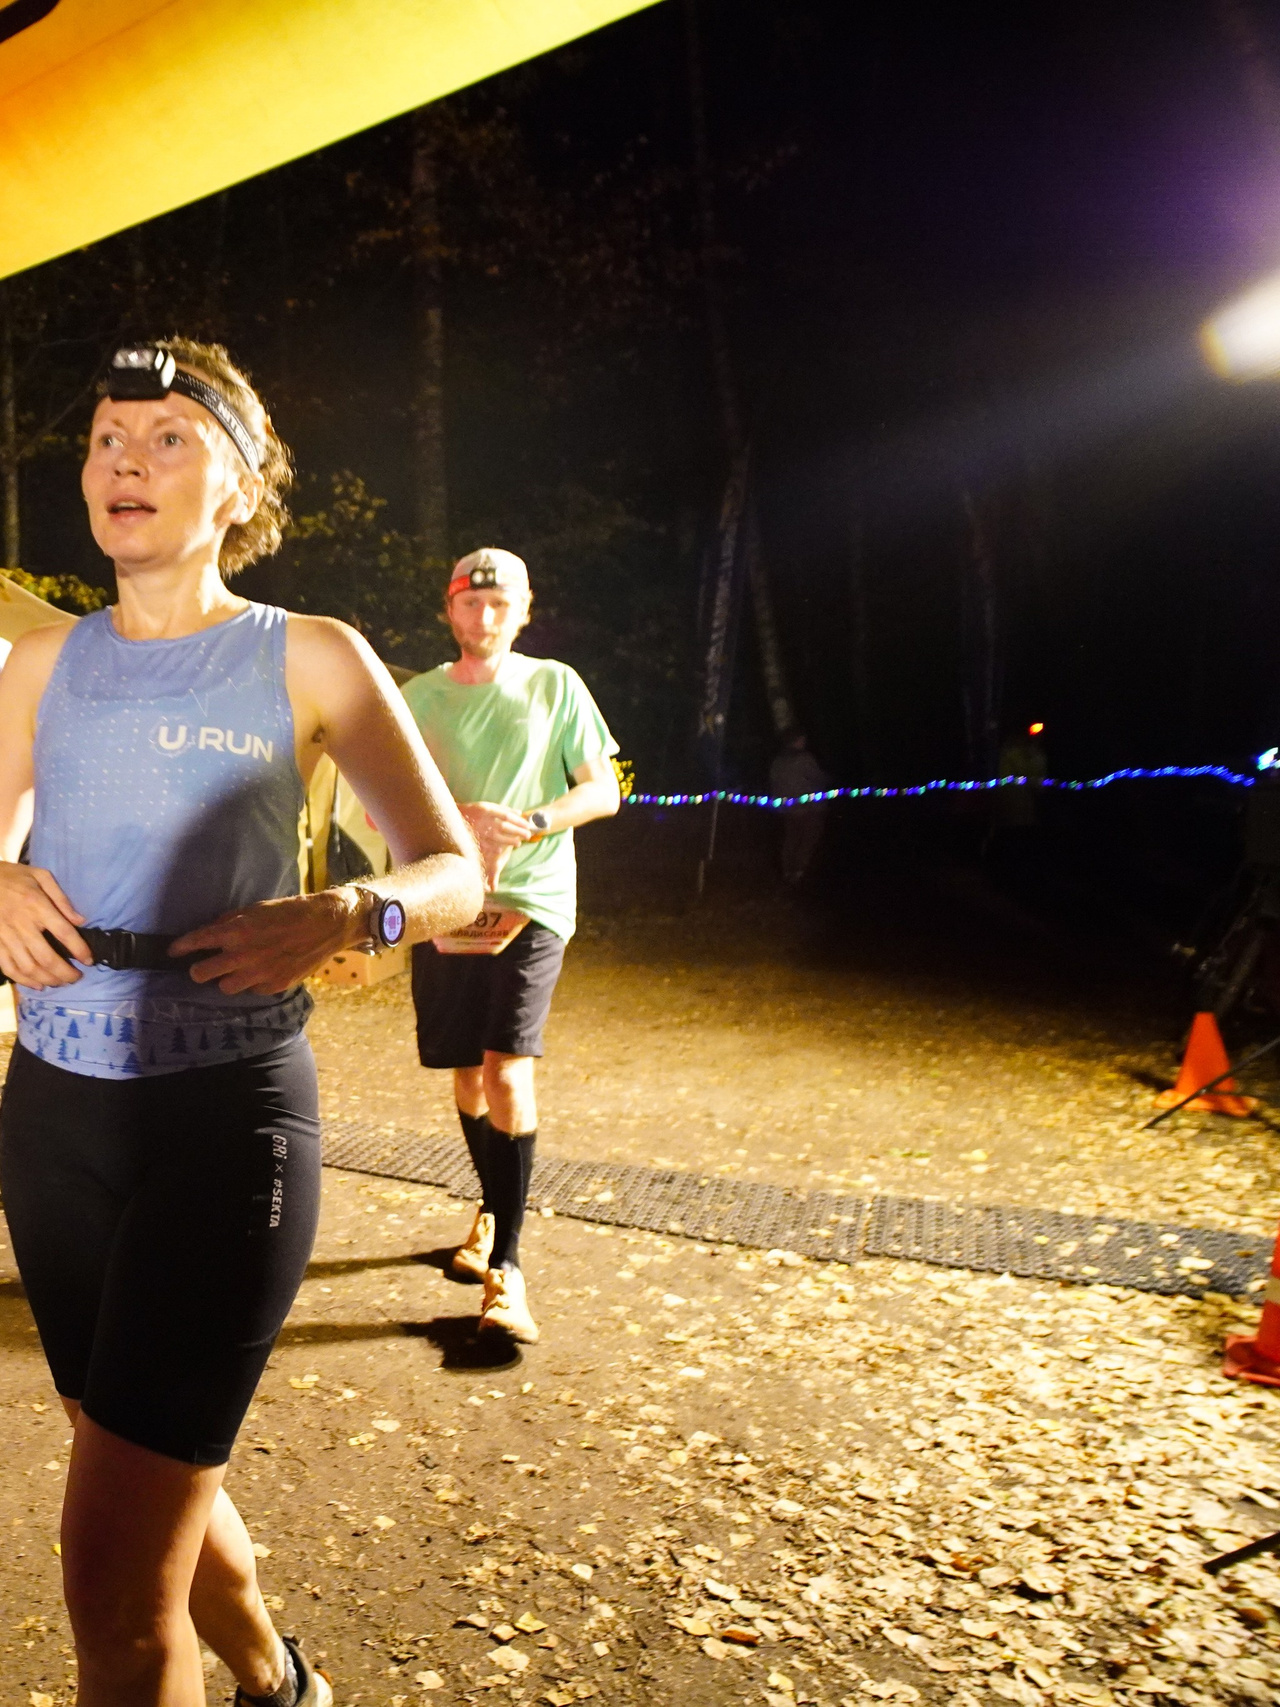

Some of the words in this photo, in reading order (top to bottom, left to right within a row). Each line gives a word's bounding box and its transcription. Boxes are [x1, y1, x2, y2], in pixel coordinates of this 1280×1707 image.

[158, 725, 188, 750] U
[198, 726, 273, 763] RUN
[269, 1178, 283, 1228] #SEKTA
